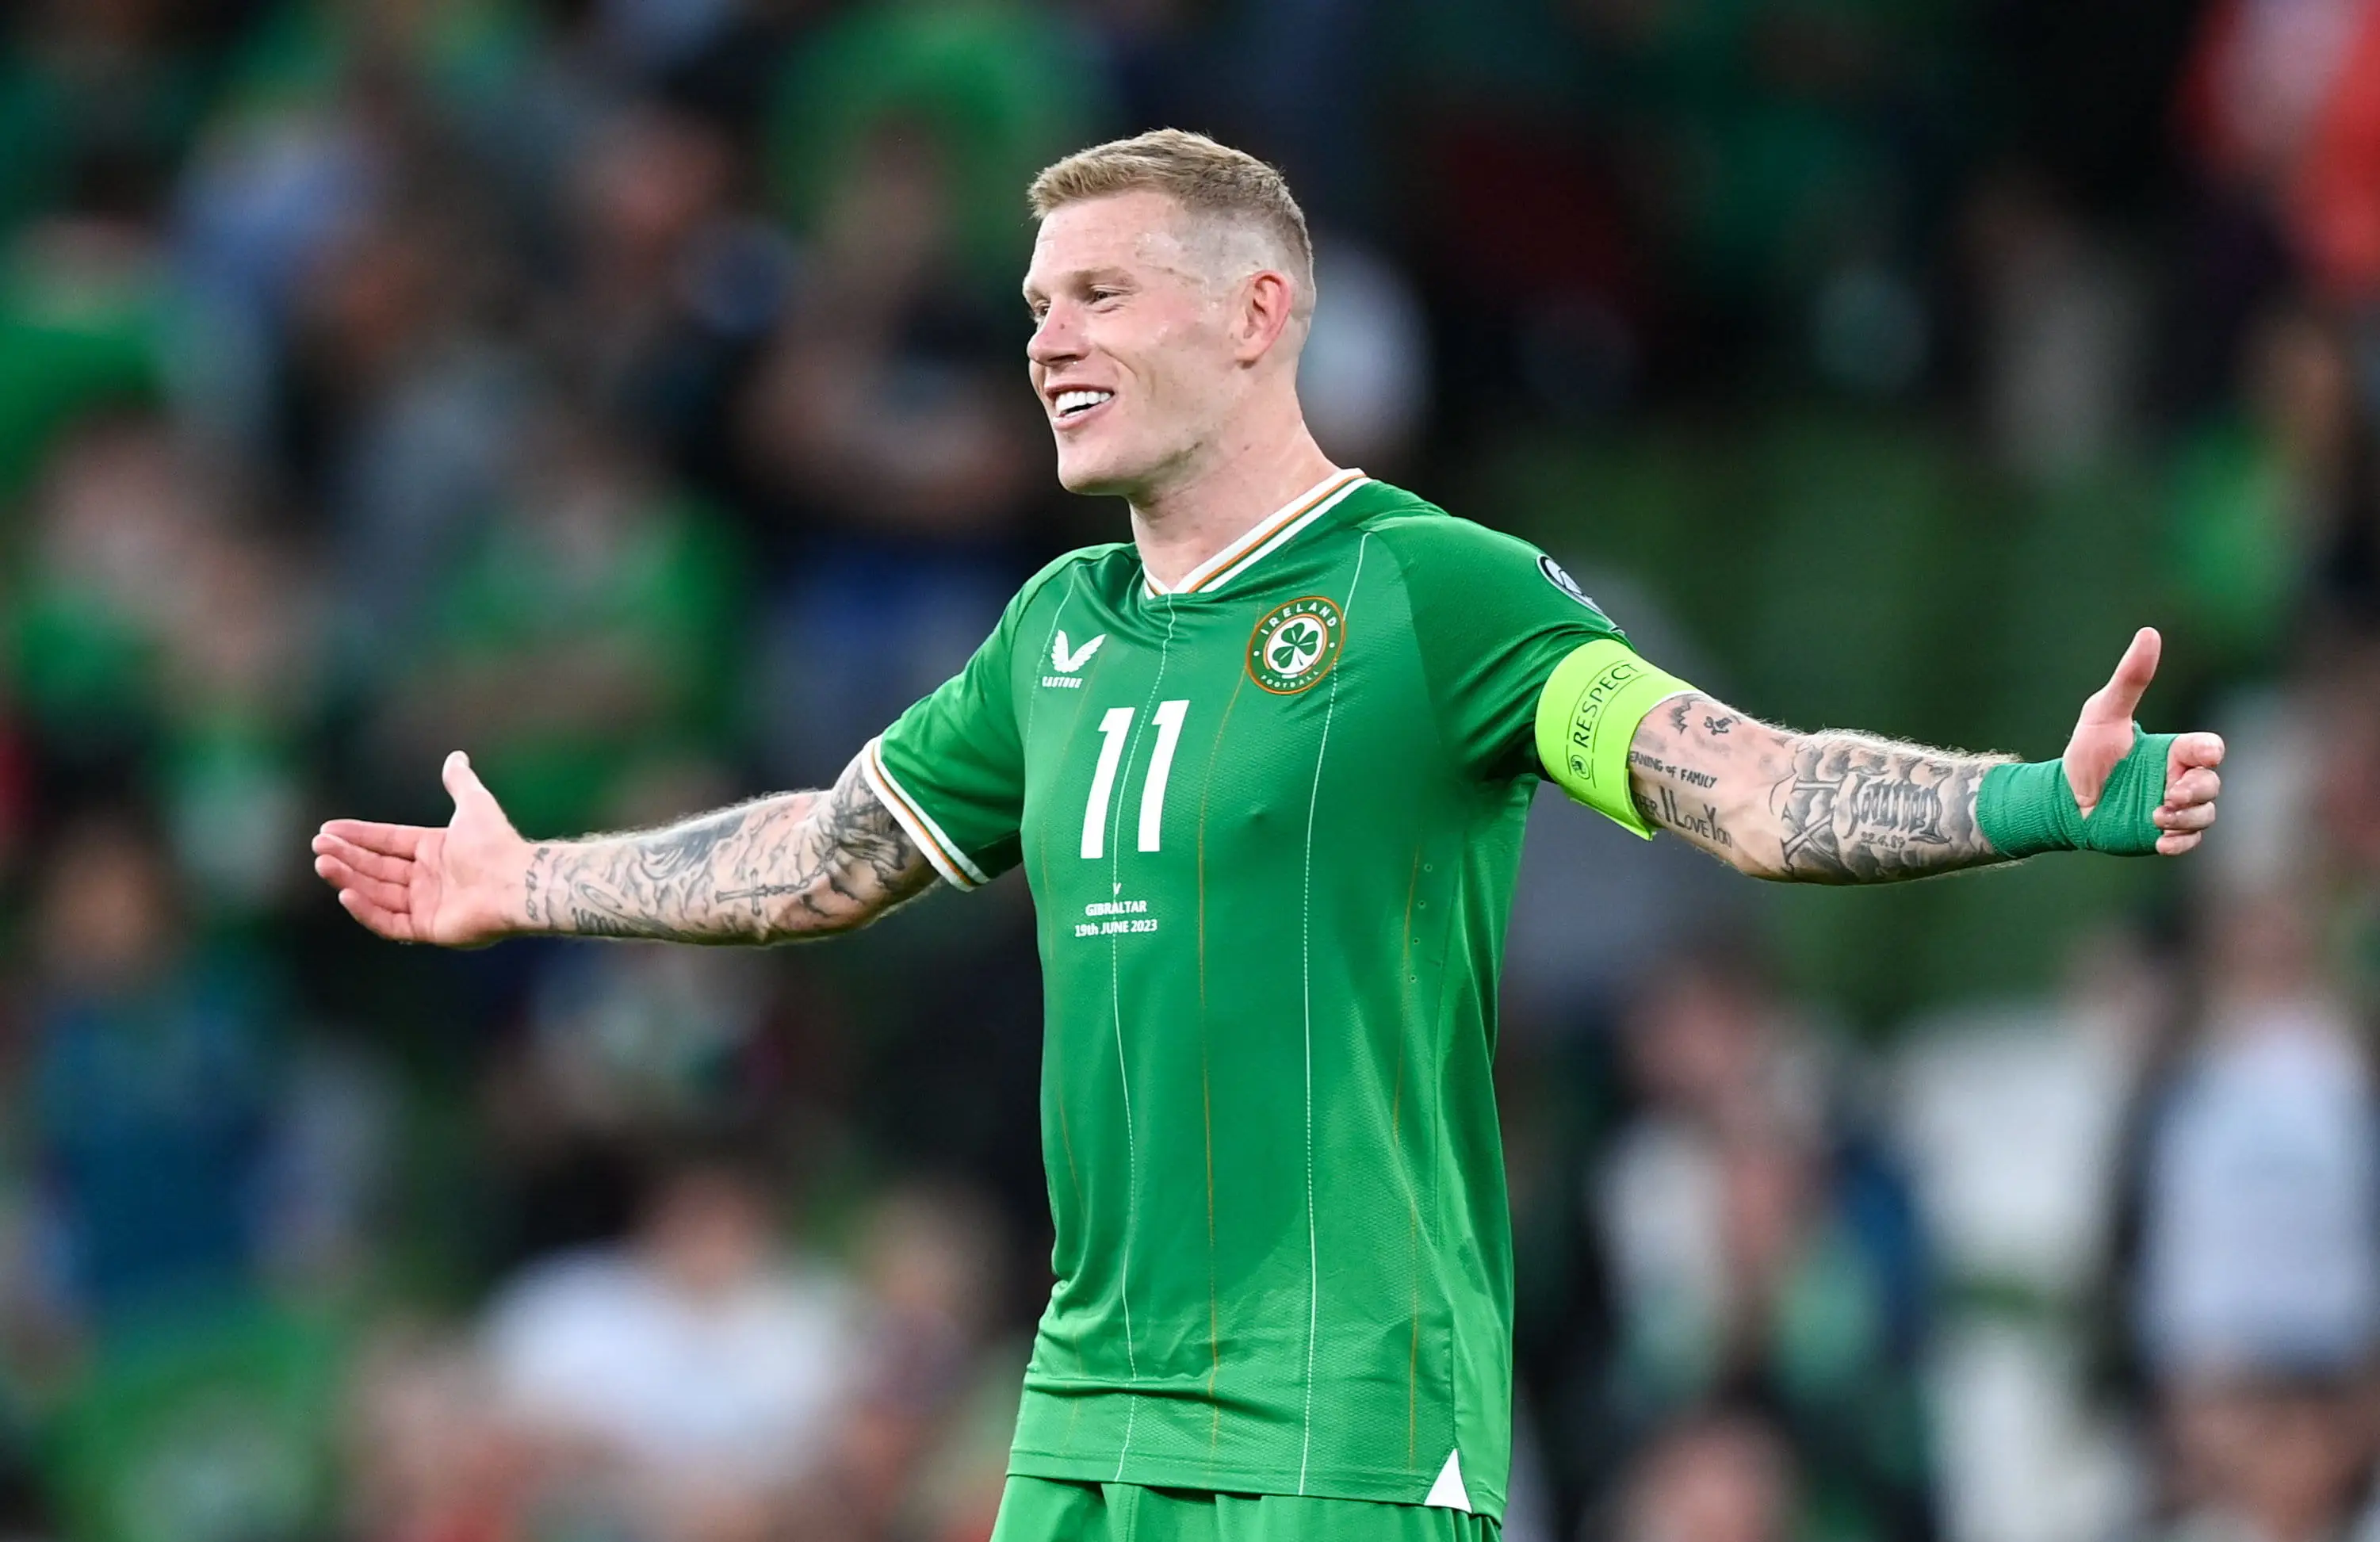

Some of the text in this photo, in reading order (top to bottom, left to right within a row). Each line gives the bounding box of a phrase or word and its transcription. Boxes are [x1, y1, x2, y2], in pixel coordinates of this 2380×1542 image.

[1261, 603, 1337, 635] IRELAND
[1042, 676, 1083, 688] CASTORE
[1261, 671, 1319, 688] FOOTBALL
[1573, 664, 1638, 748] RESPECT
[1080, 699, 1190, 859] 11
[1630, 751, 1663, 771] EANING
[1681, 768, 1717, 788] FAMILY
[1085, 901, 1147, 916] GIBRALTAR
[1075, 919, 1157, 937] 19th JUNE 2023
